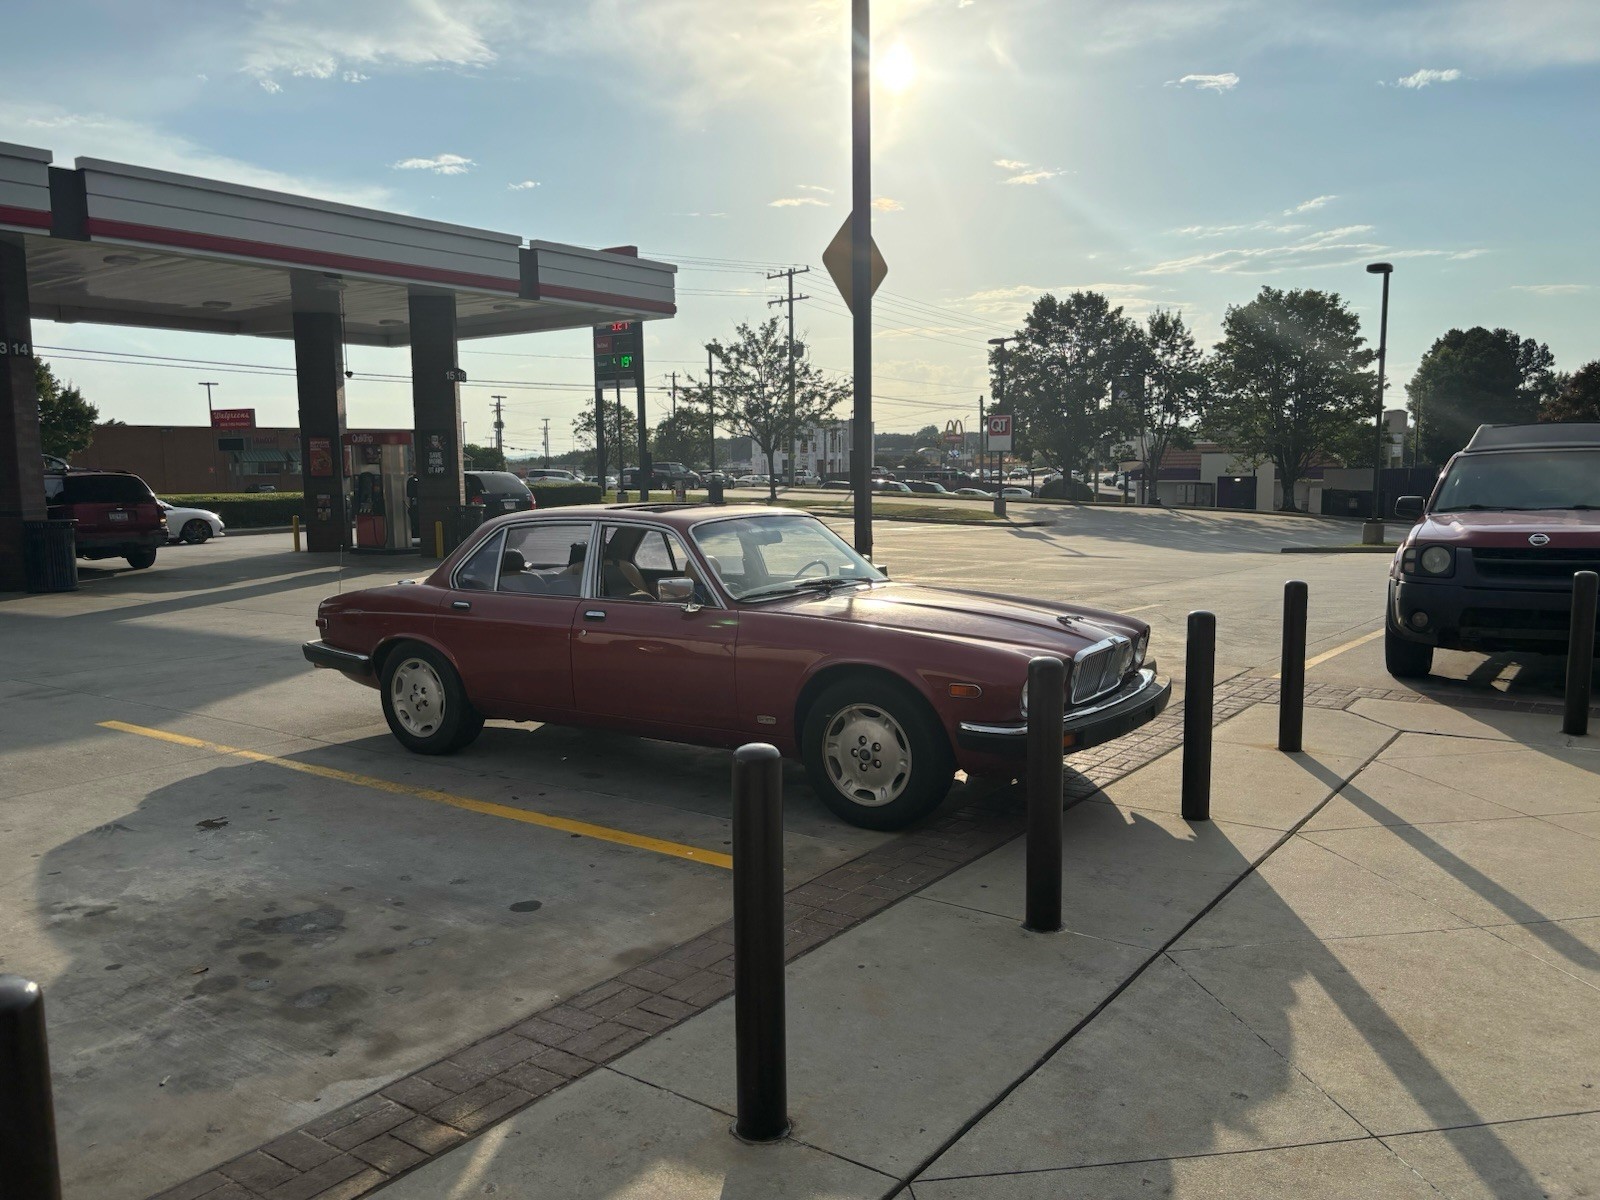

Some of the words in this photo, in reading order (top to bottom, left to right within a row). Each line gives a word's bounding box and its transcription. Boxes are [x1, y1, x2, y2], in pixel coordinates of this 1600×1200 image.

[13, 343, 29, 355] 14
[446, 371, 455, 380] 15
[213, 411, 250, 420] Walgreens
[991, 418, 1007, 433] QT
